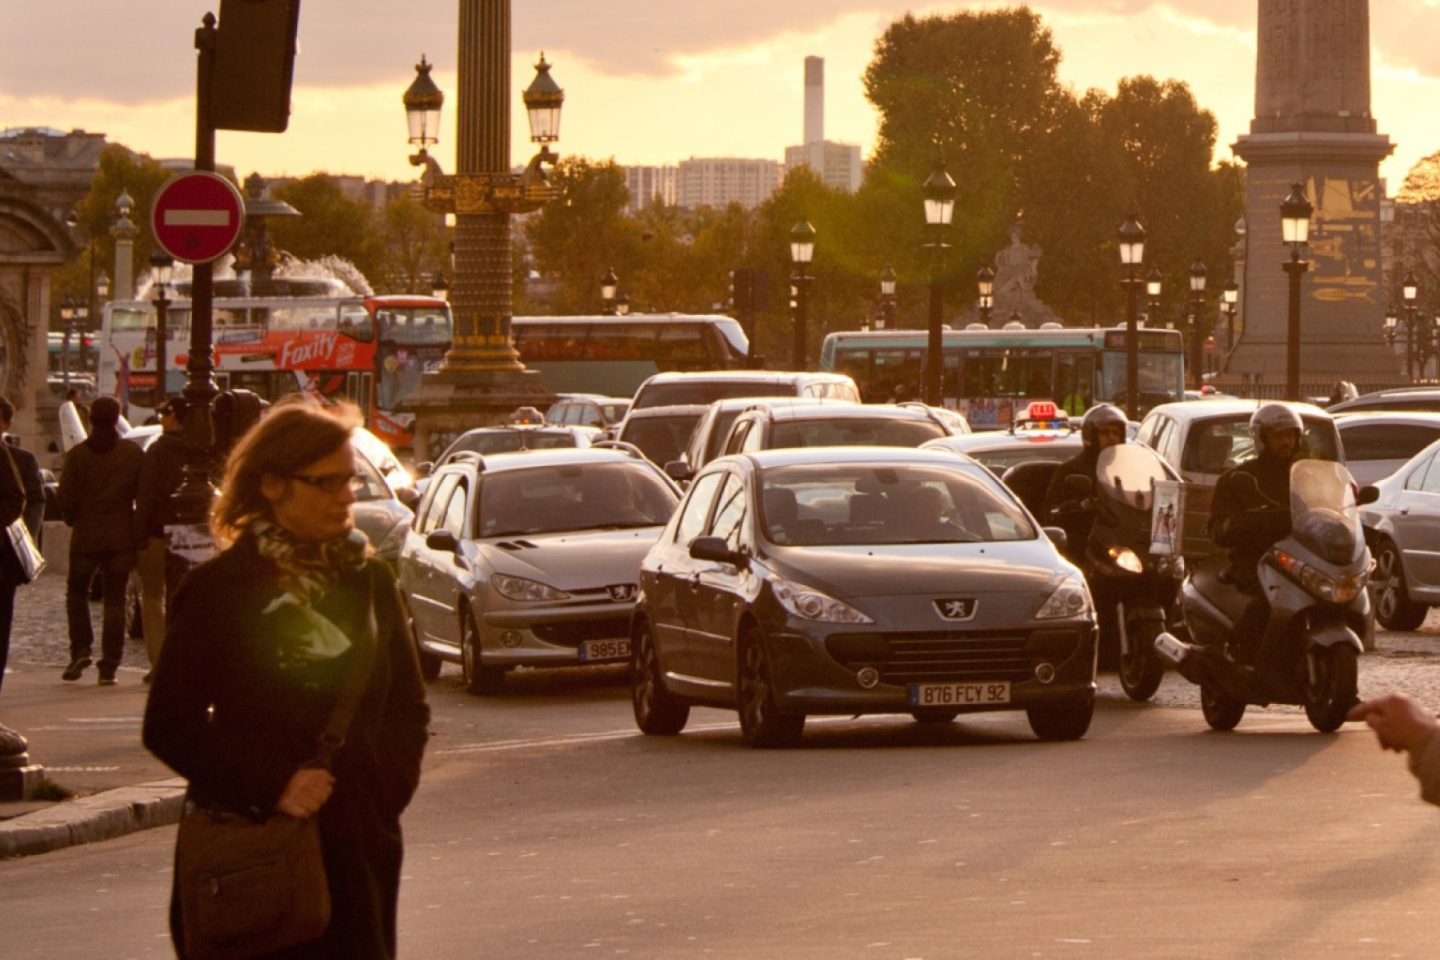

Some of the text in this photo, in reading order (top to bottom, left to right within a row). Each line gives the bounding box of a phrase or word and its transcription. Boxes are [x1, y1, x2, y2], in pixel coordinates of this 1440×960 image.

[280, 333, 338, 369] Foxity
[1032, 403, 1054, 415] TAXI
[924, 684, 1006, 703] 876 FCY 92
